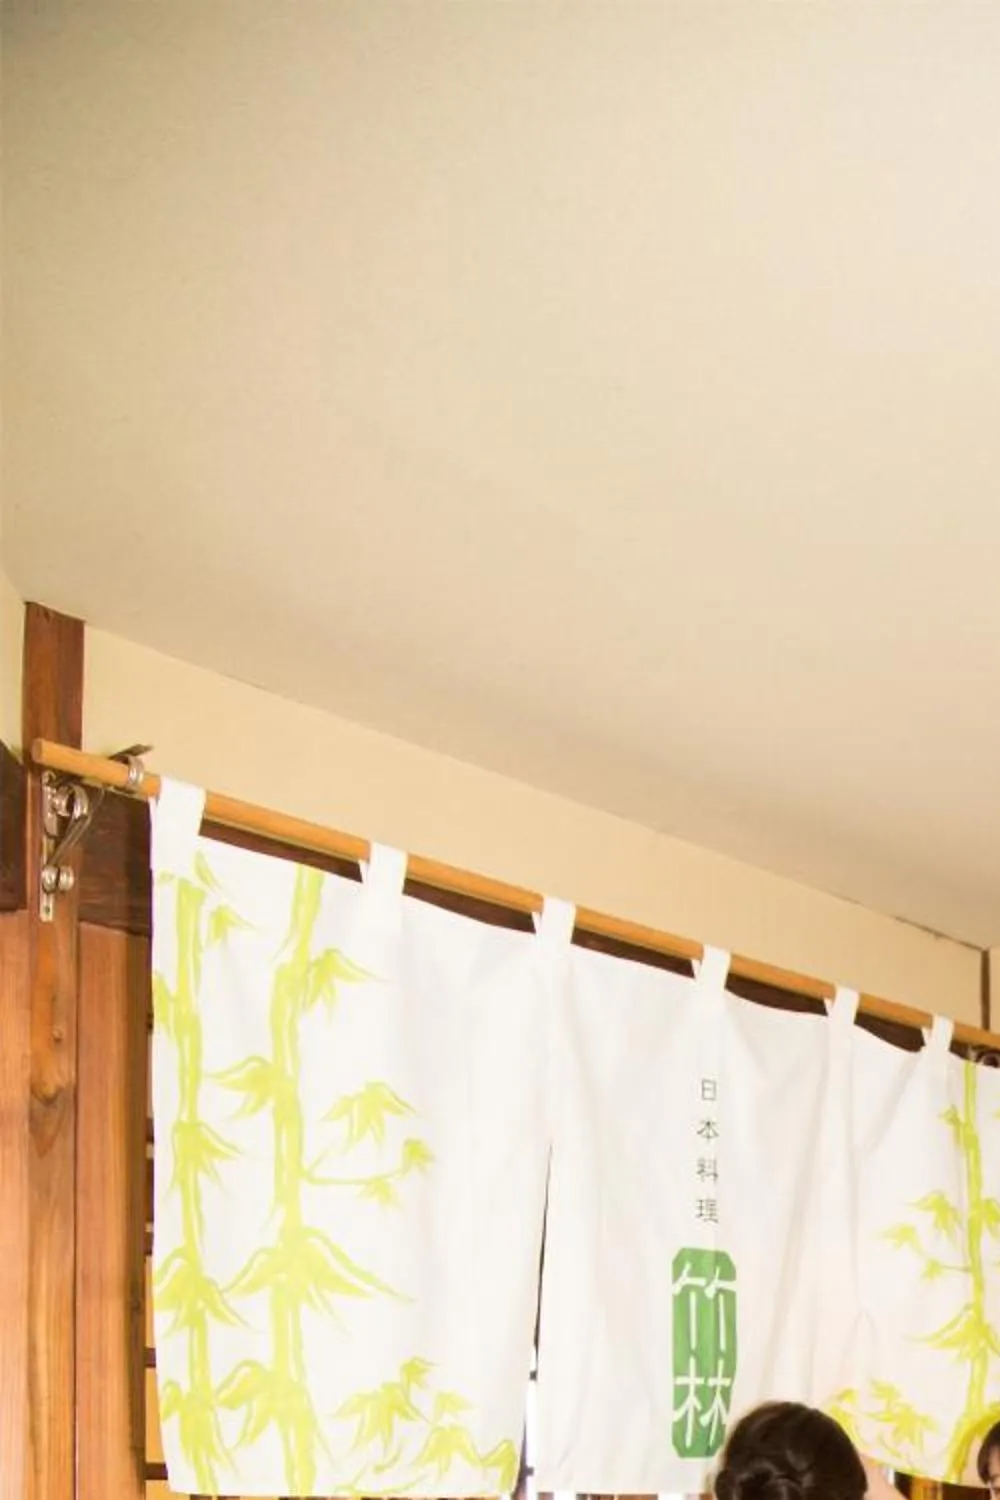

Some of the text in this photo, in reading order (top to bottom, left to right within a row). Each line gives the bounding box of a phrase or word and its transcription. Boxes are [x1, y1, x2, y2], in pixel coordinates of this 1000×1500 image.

[696, 1078, 719, 1222] 日本料理
[673, 1261, 737, 1449] 竹林
